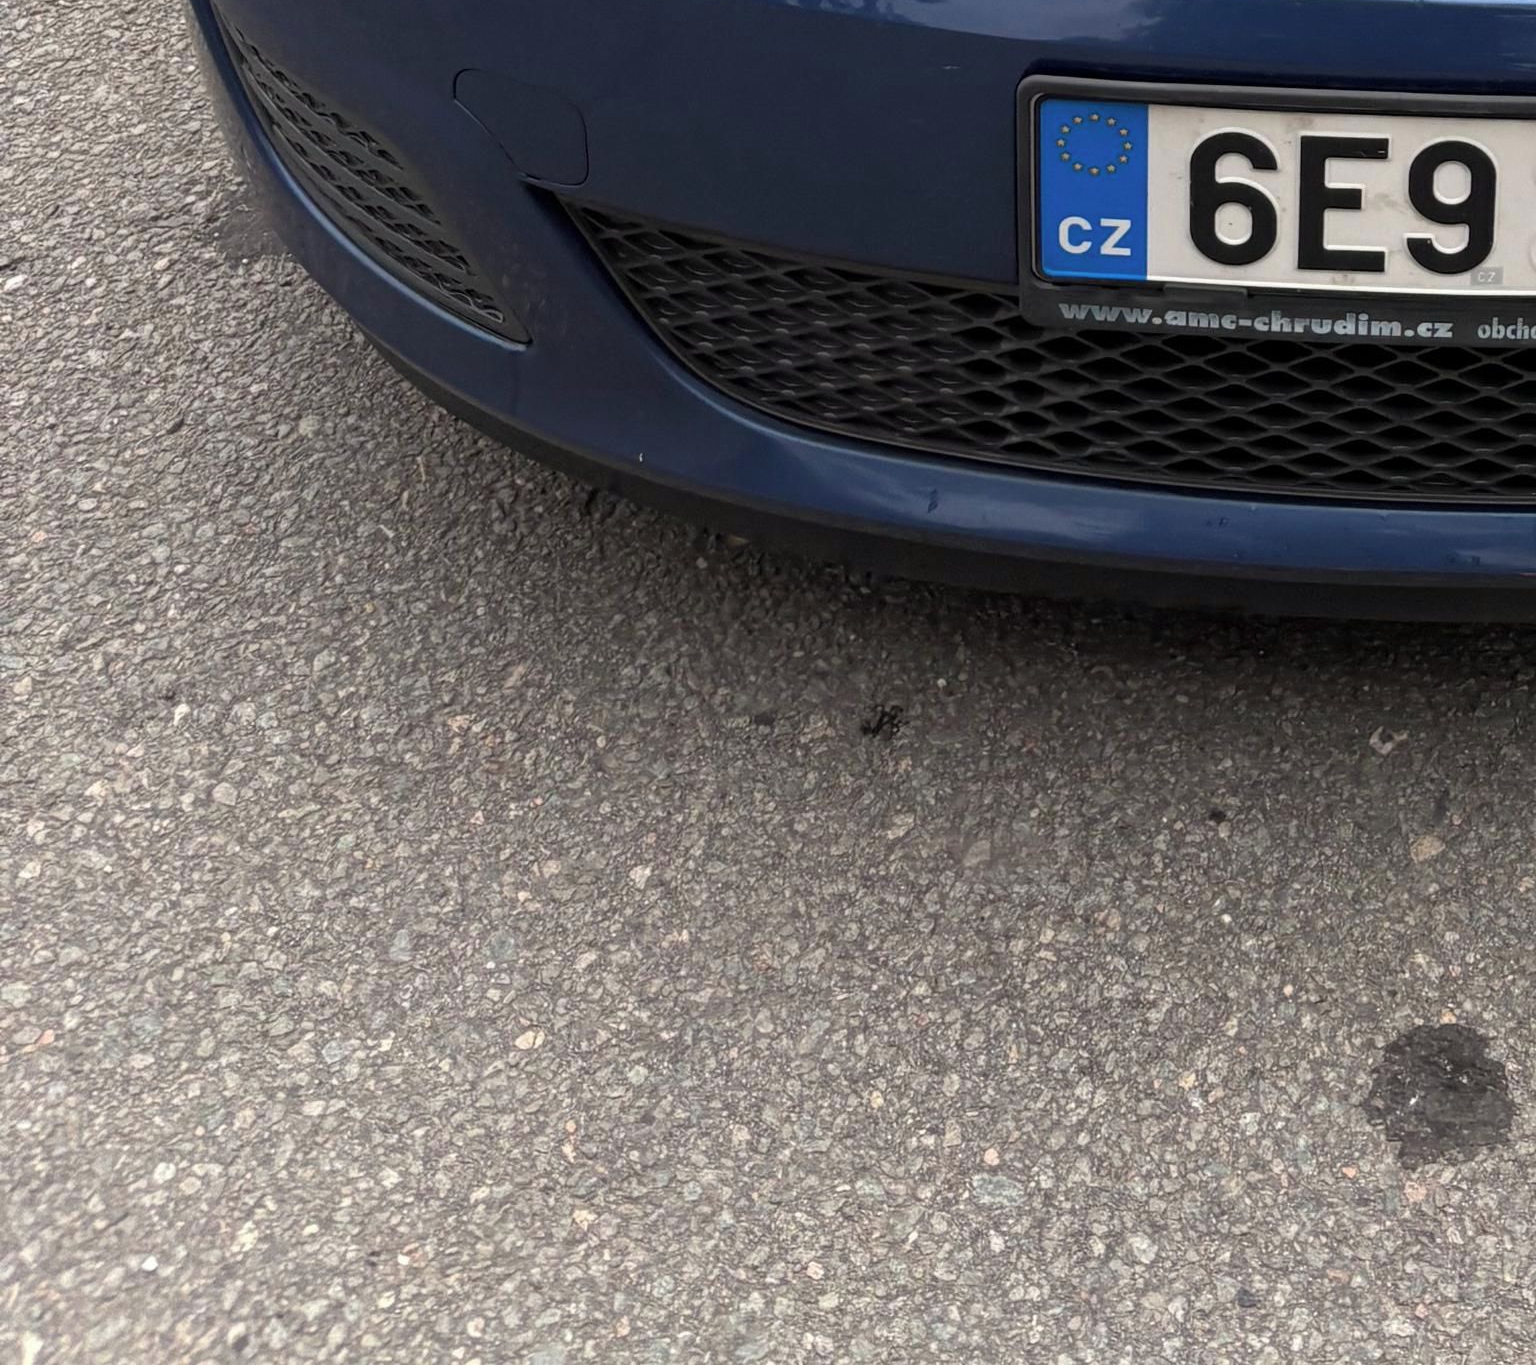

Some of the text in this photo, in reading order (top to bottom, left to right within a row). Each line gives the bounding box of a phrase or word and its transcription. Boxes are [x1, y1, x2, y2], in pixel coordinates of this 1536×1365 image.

[1189, 131, 1497, 275] 6E9
[1058, 216, 1132, 257] CZ
[1058, 302, 1453, 338] www.amc-chrudim.cz
